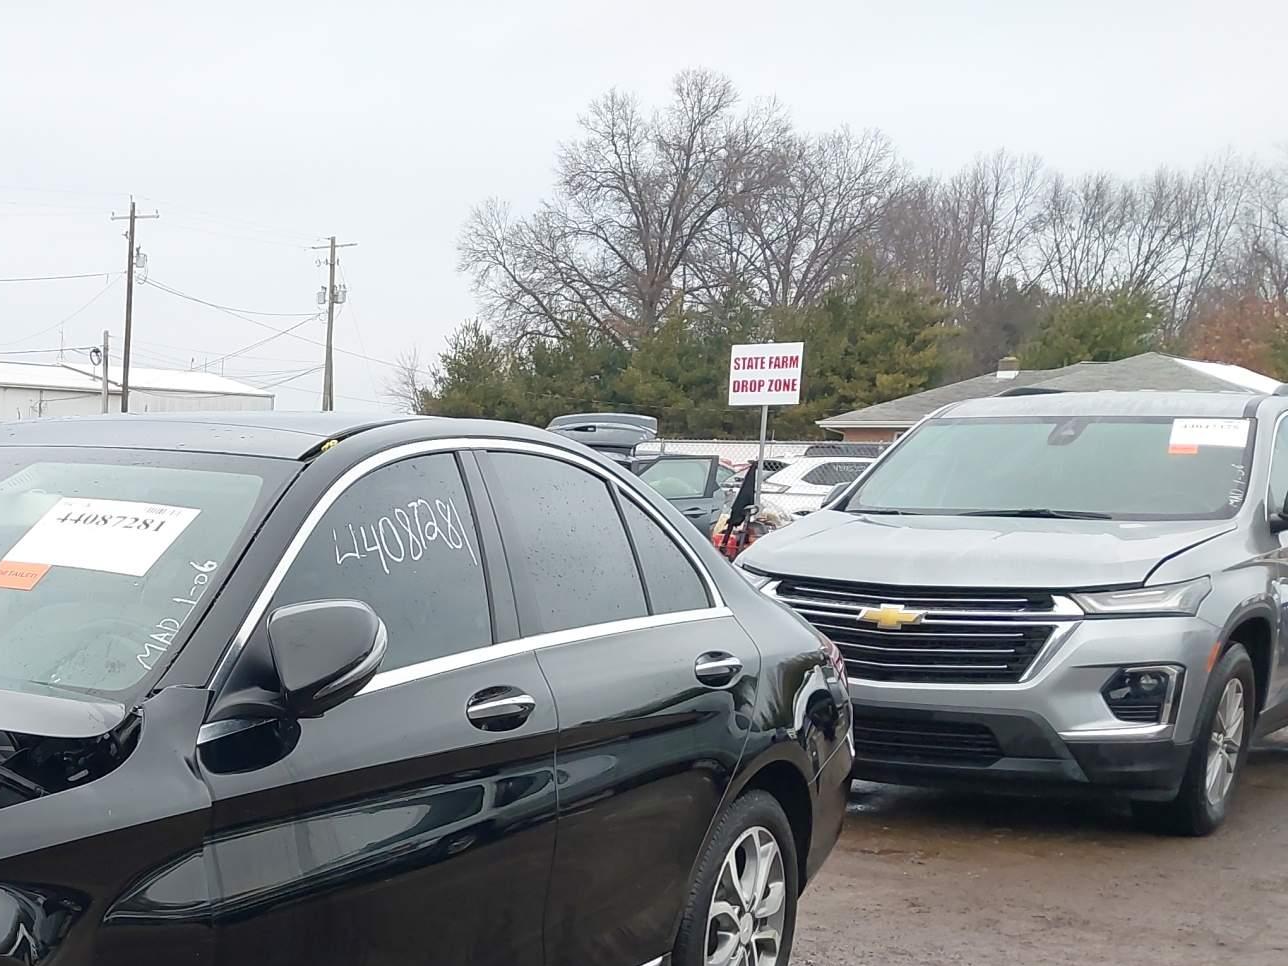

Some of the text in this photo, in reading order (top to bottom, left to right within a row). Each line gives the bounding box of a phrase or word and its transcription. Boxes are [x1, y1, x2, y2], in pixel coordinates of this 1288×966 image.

[733, 355, 799, 371] STATE FARM
[732, 378, 798, 393] DROP ZONE
[56, 510, 166, 532] 44087281
[332, 497, 478, 574] 44087281
[136, 560, 217, 670] MAD 1-06
